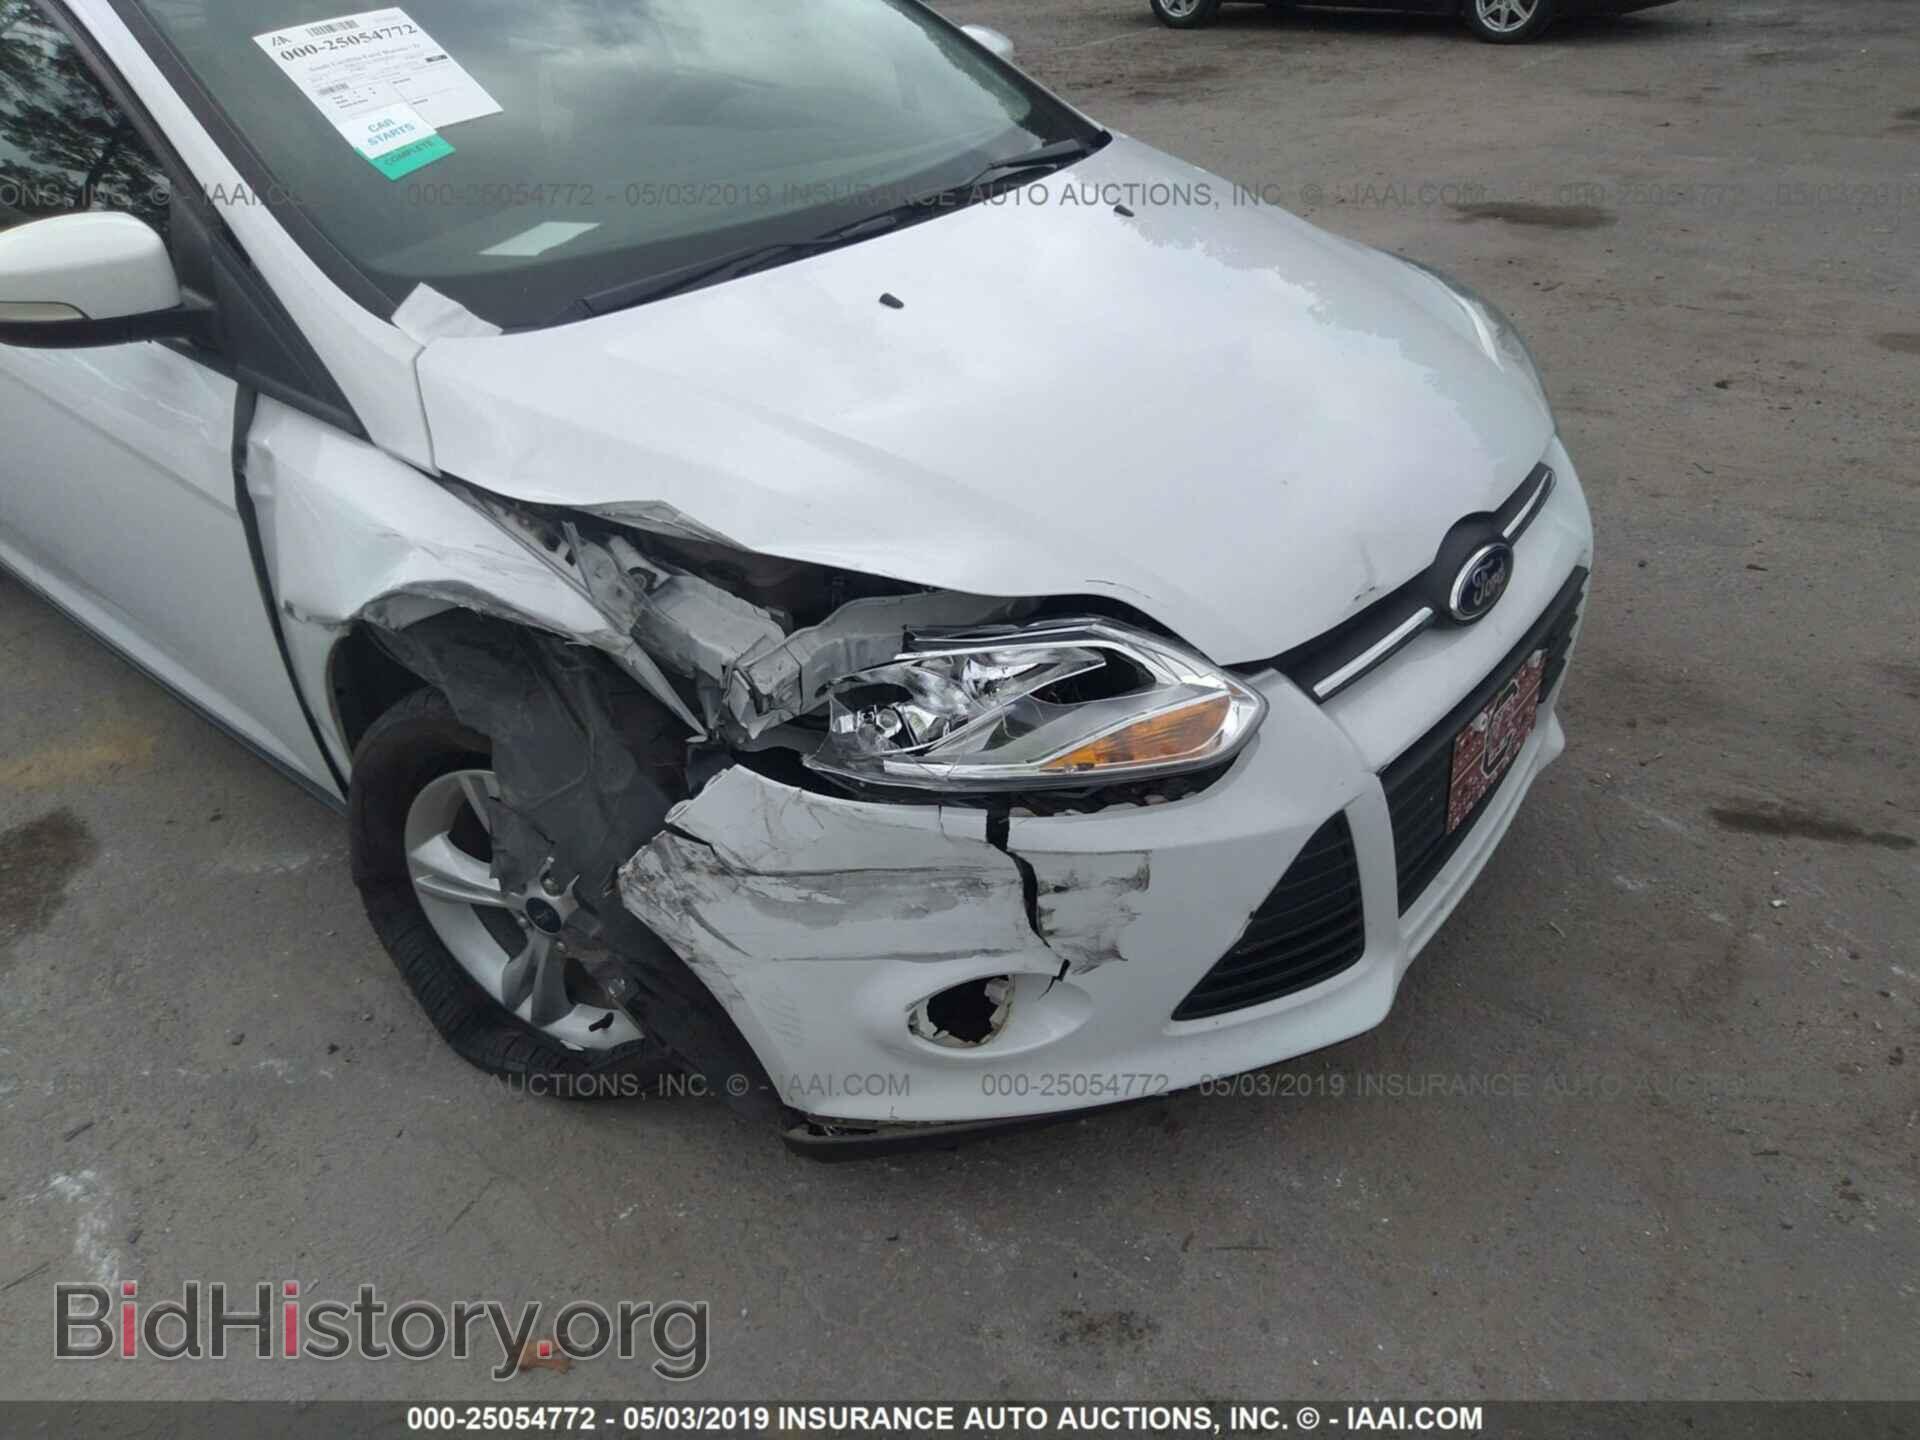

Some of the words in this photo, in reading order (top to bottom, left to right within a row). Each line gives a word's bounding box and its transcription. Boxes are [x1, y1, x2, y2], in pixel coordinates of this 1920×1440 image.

[280, 24, 418, 61] 000-25054772
[367, 118, 395, 132] CAR
[367, 123, 416, 146] STARTS
